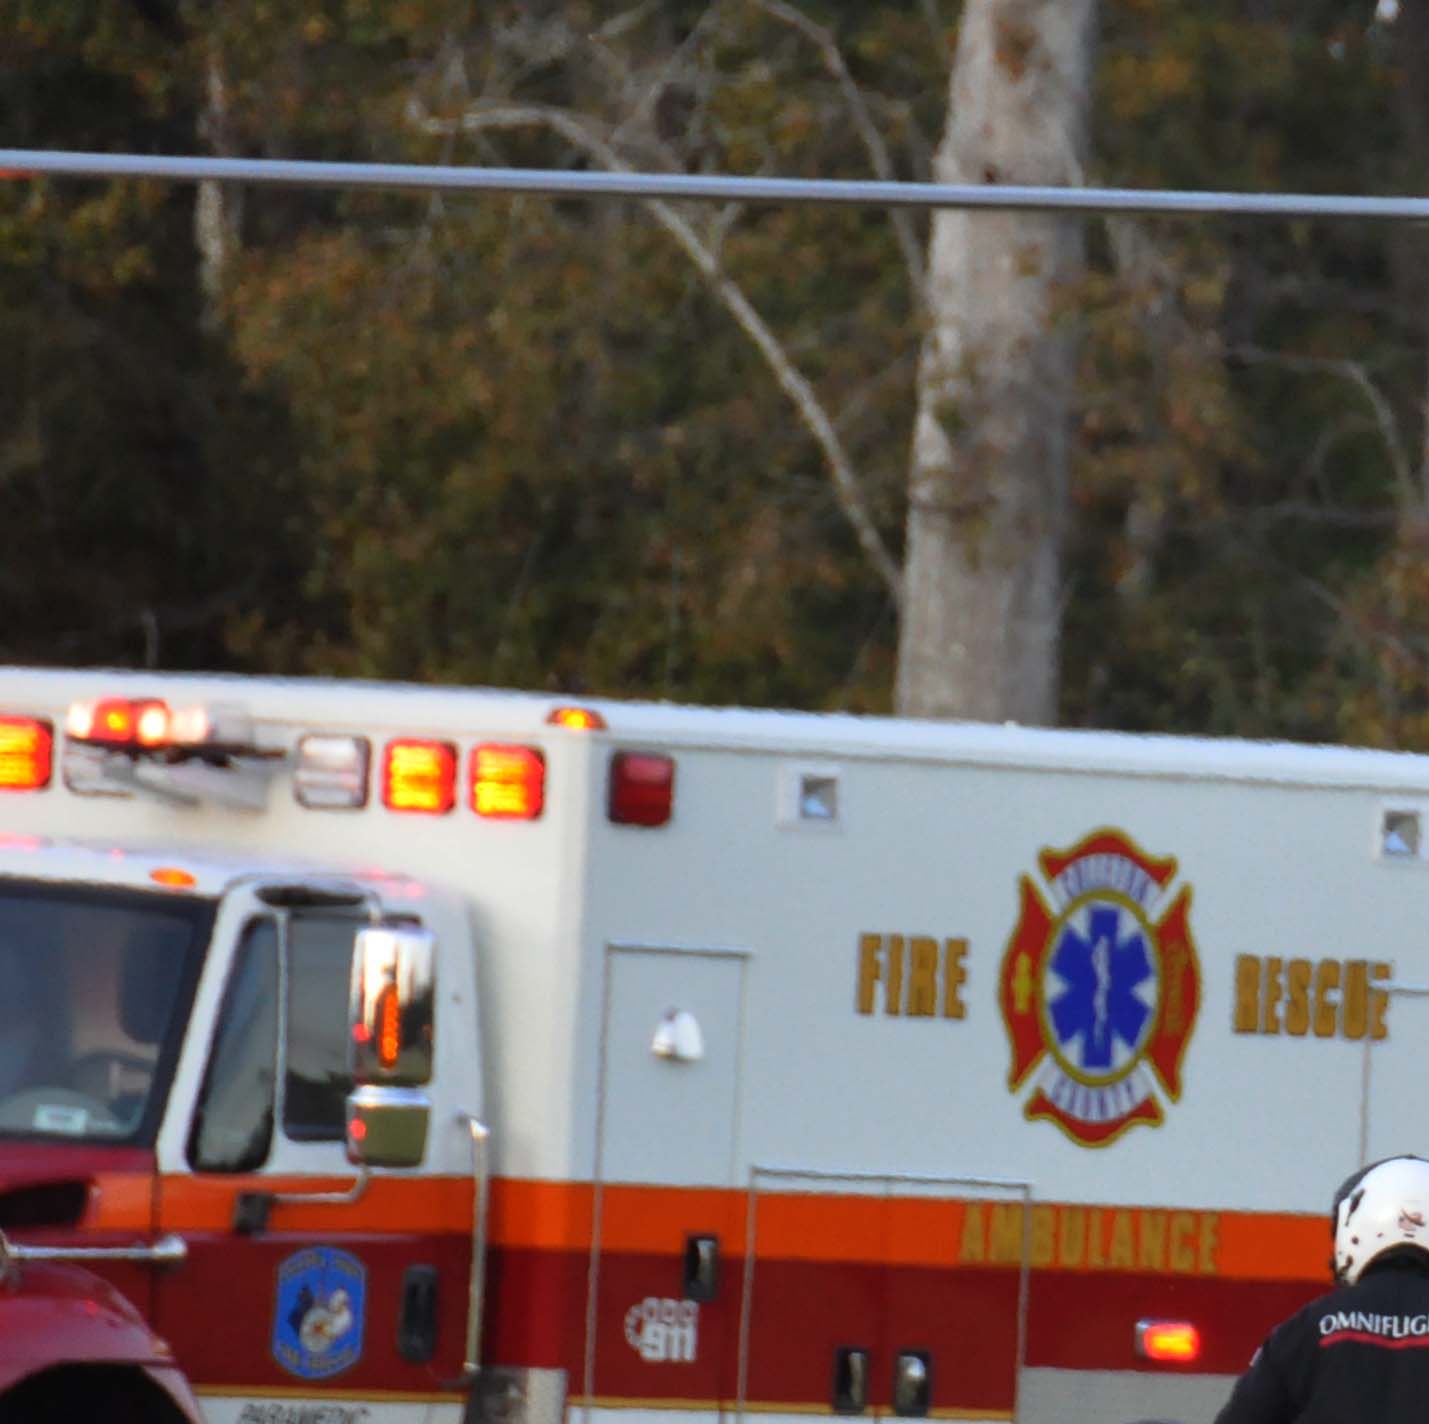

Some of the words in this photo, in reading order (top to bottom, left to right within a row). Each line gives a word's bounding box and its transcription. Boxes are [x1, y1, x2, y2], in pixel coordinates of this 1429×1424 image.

[854, 931, 969, 1021] FIRE
[1230, 952, 1392, 1041] RESCUE
[958, 1201, 1221, 1276] AMBULANCE
[640, 1320, 697, 1361] 911
